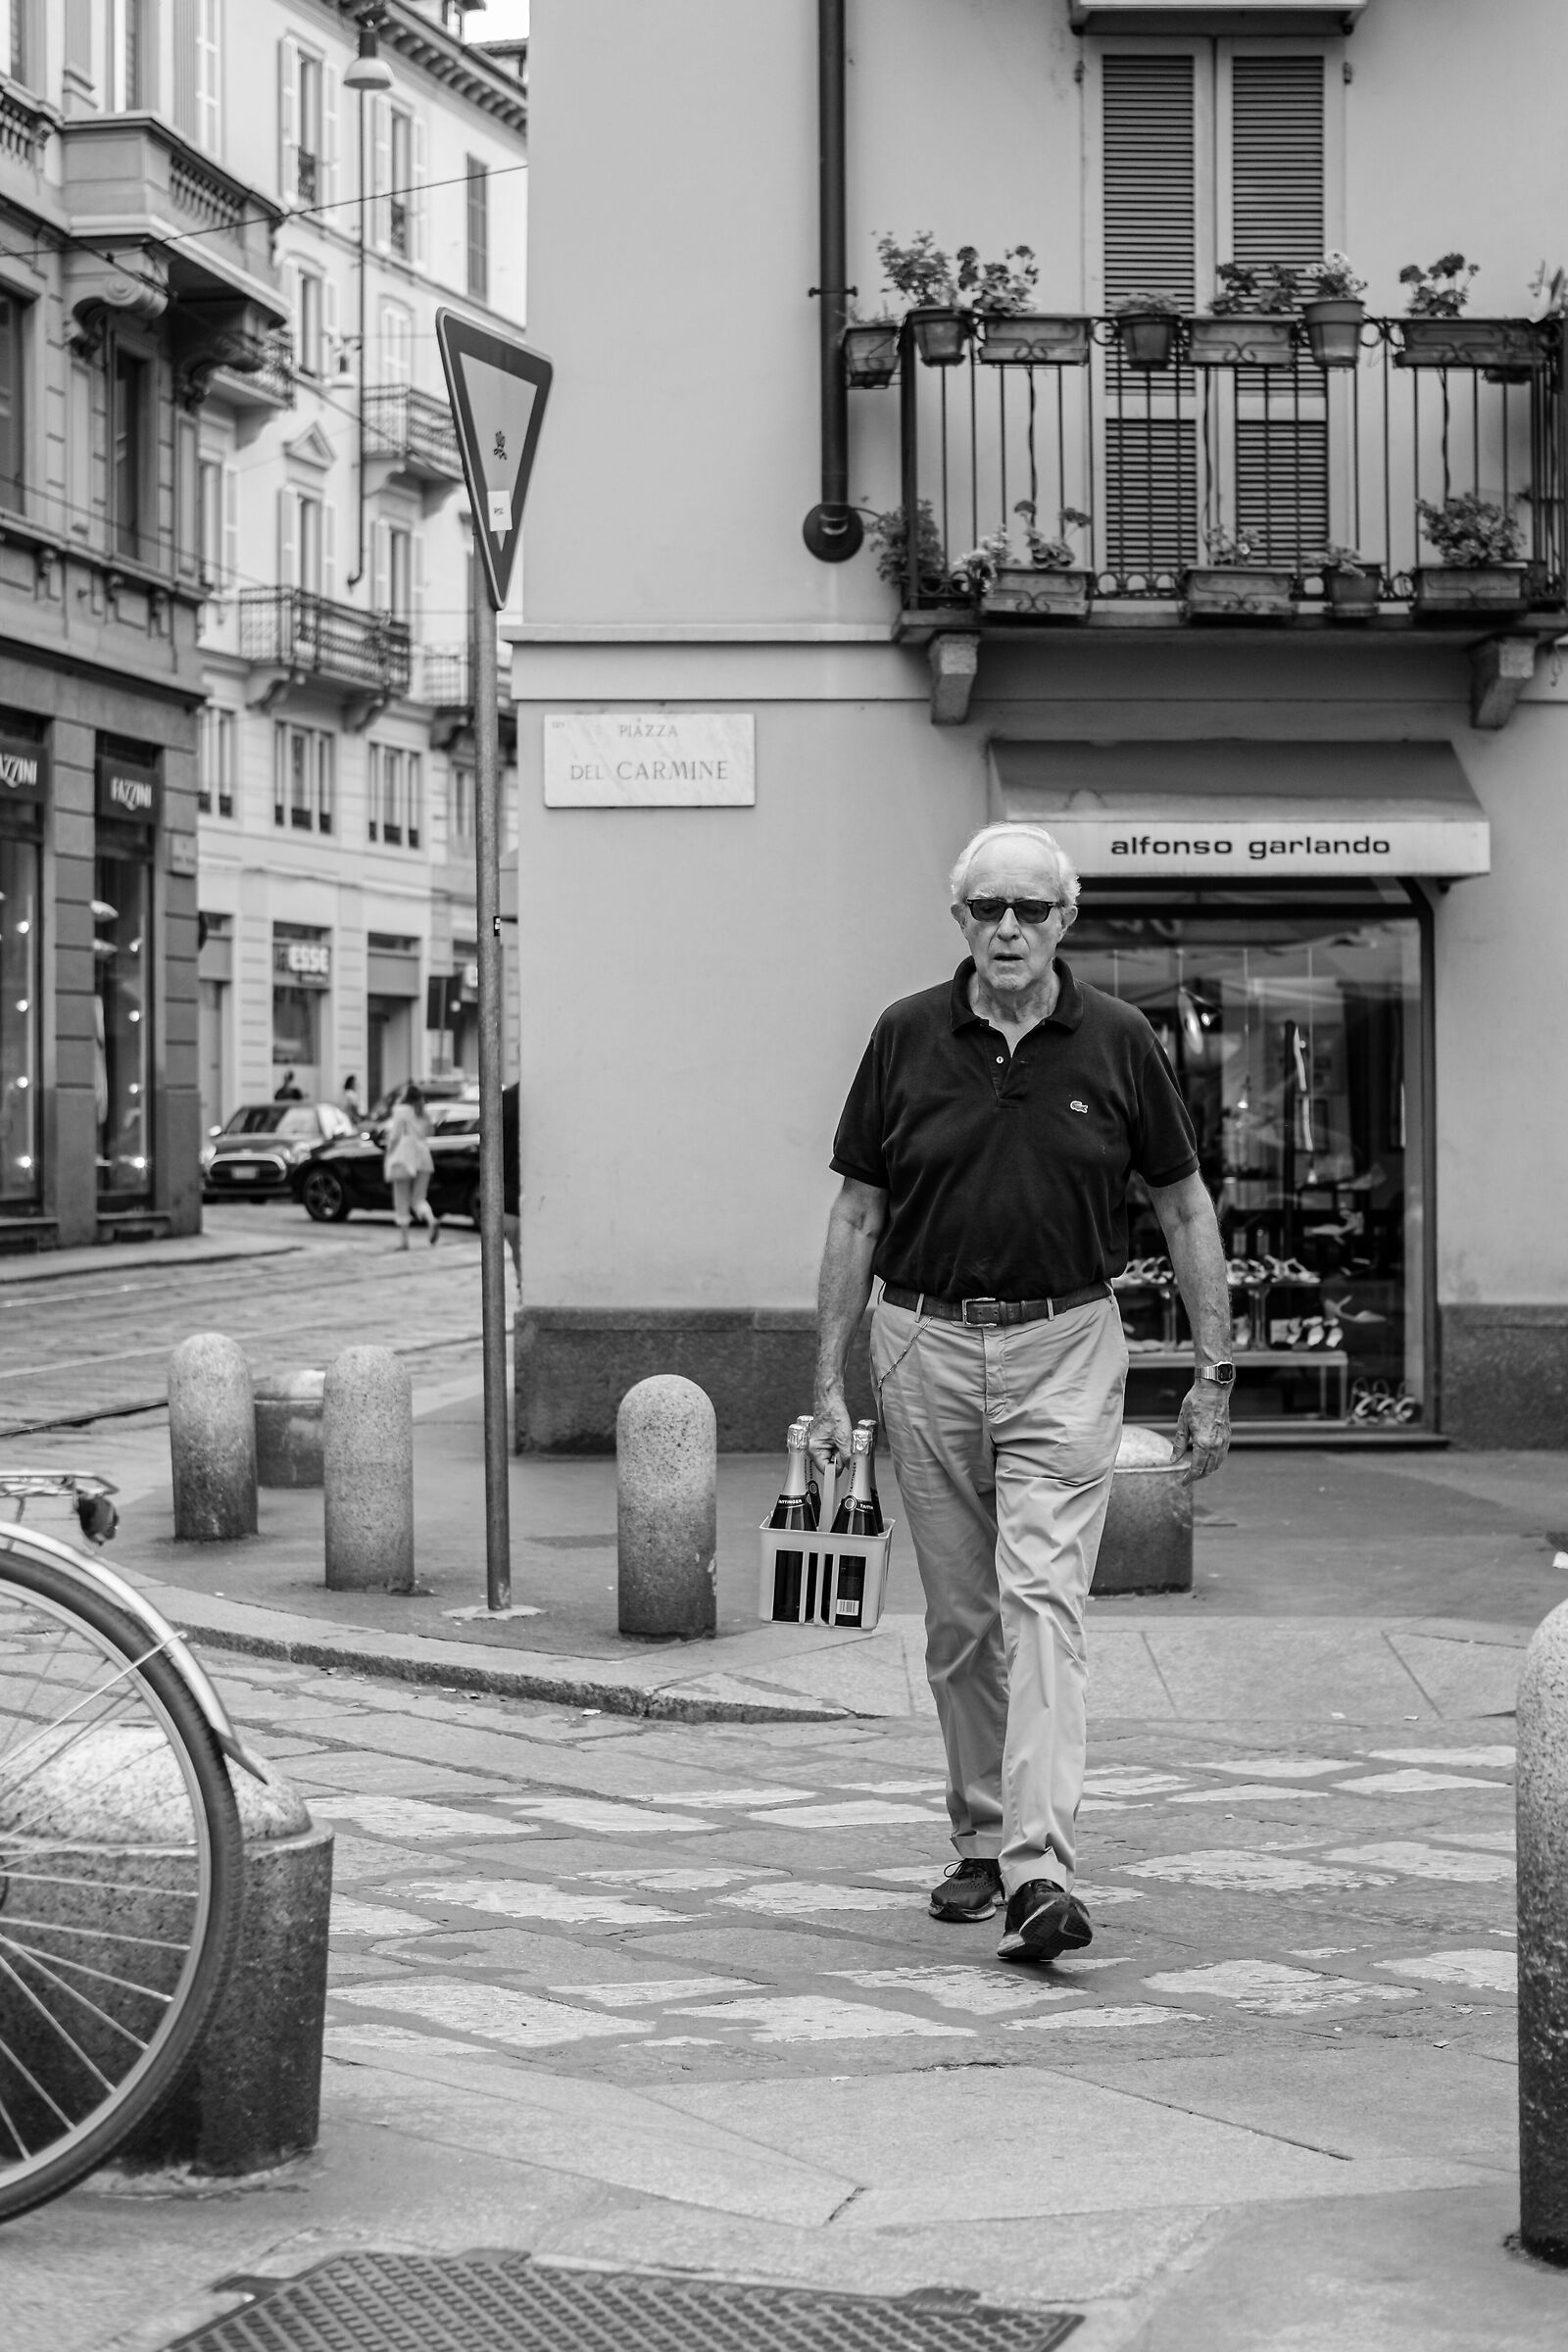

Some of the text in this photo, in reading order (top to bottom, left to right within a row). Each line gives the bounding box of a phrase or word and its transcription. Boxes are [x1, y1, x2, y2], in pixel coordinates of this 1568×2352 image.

[618, 723, 678, 738] PIAZZA
[570, 760, 729, 781] DEL CARMINE
[110, 776, 152, 810] FAZZINI
[1110, 836, 1391, 859] alfonso garlando
